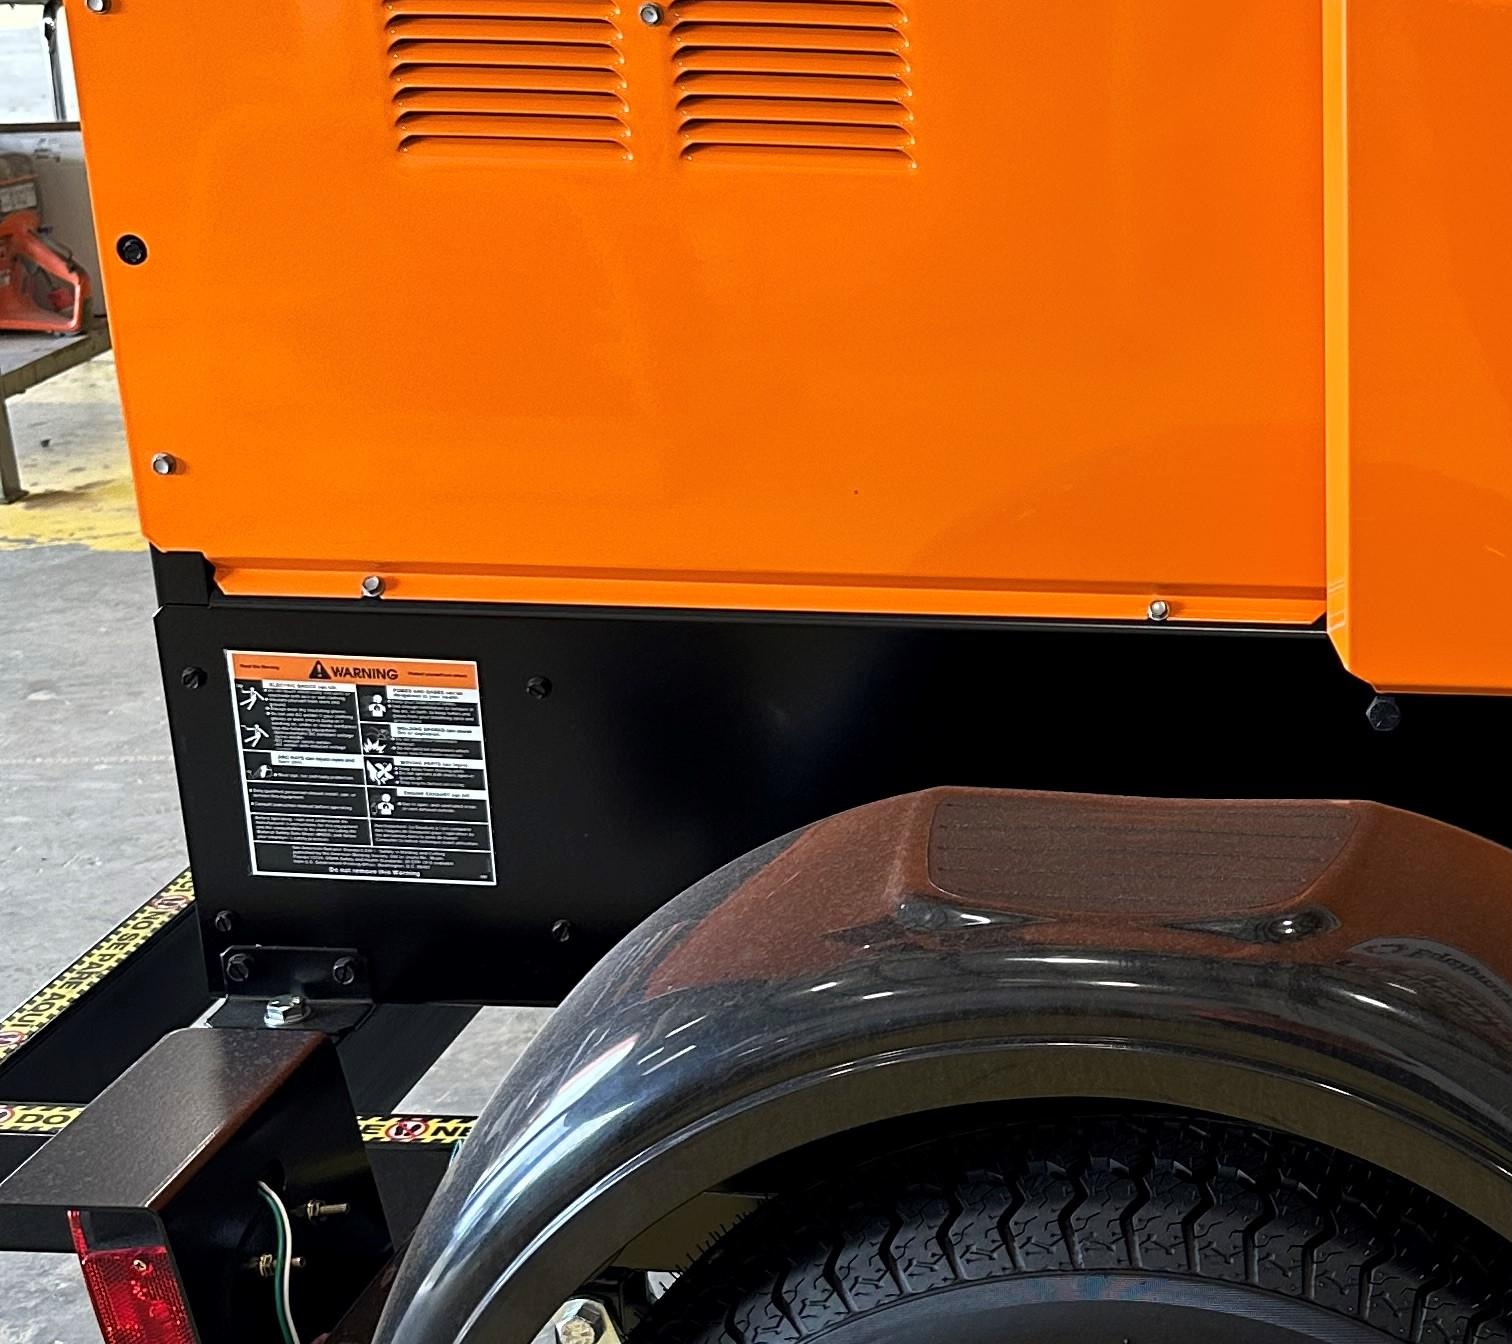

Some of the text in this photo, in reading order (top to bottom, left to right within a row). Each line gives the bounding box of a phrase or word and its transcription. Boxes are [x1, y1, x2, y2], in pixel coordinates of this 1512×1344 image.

[331, 666, 399, 681] WARNING
[132, 910, 165, 931] NO
[105, 932, 140, 951] SE
[57, 953, 117, 991] PARE
[15, 1113, 71, 1125] DO
